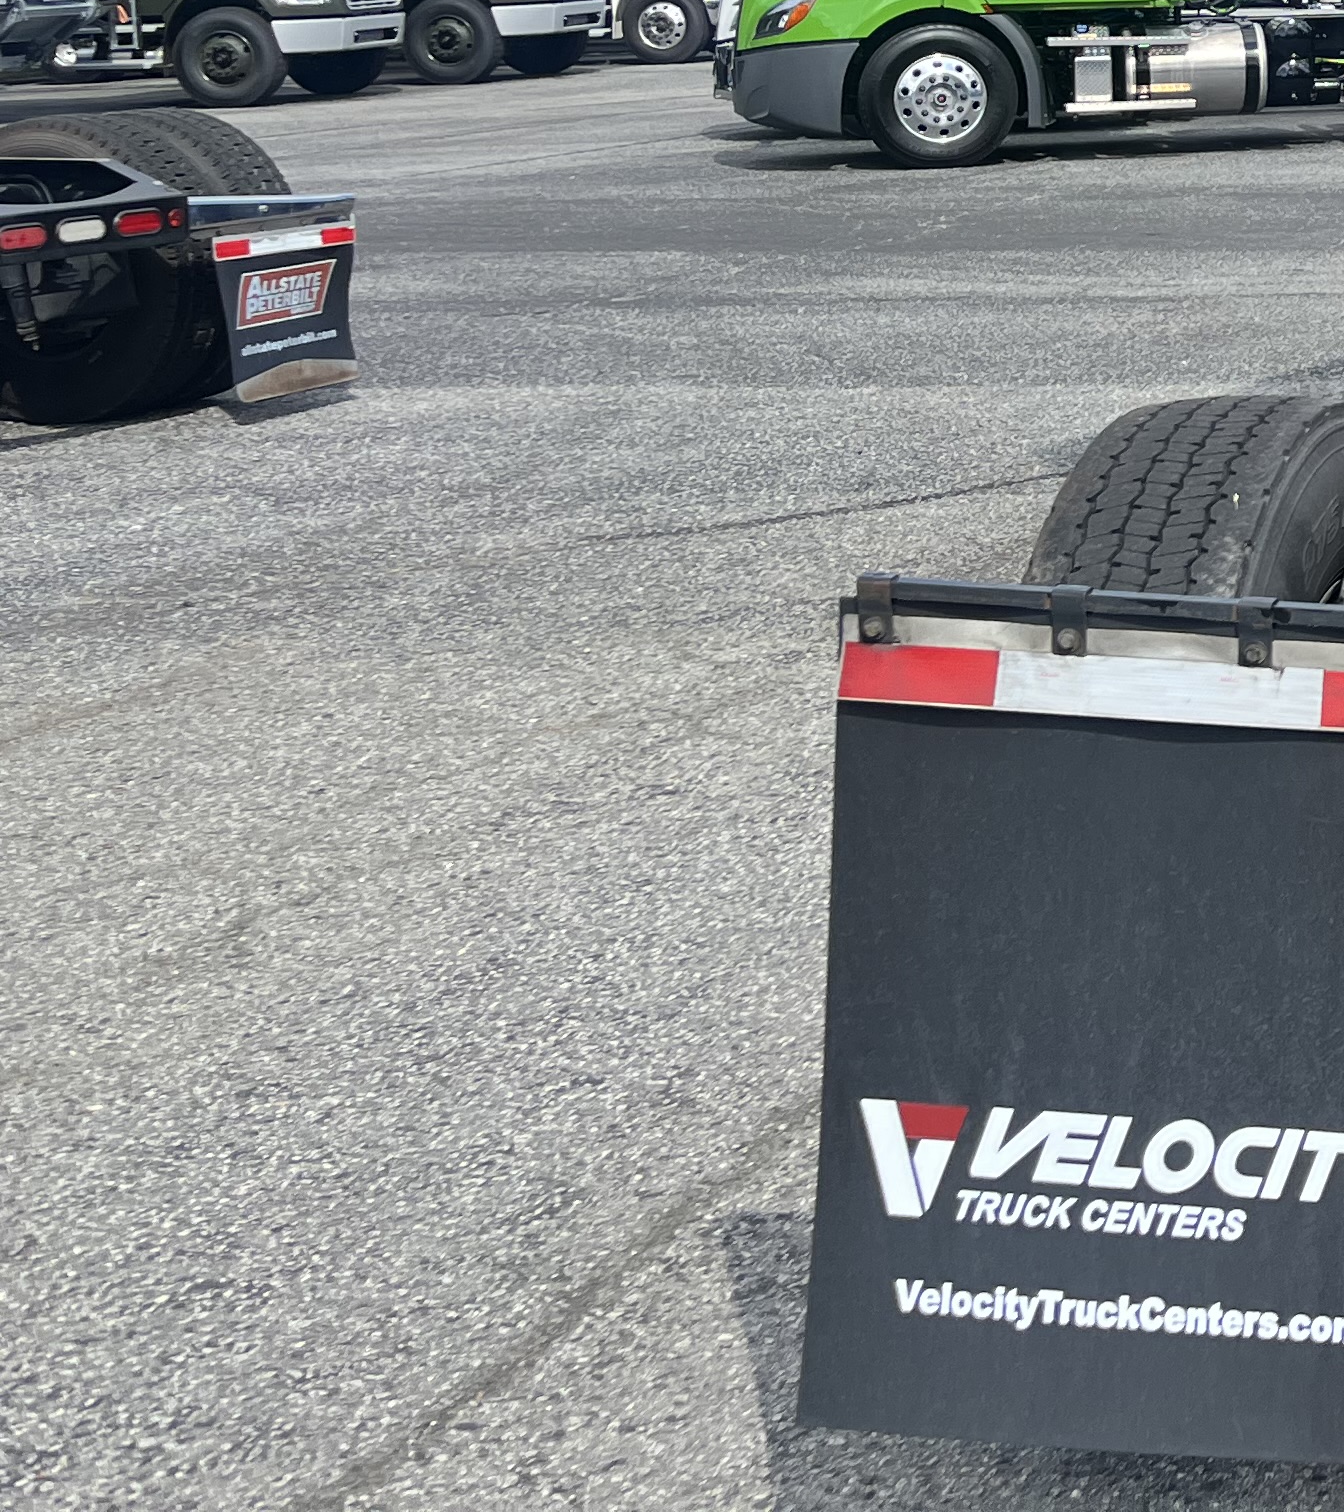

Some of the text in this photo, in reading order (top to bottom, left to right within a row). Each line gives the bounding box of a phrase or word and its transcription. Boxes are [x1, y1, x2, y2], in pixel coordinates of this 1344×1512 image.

[247, 272, 322, 298] ALLSTATE
[246, 287, 320, 319] PETERBILT
[955, 1189, 1248, 1242] TRUCK CENTERS
